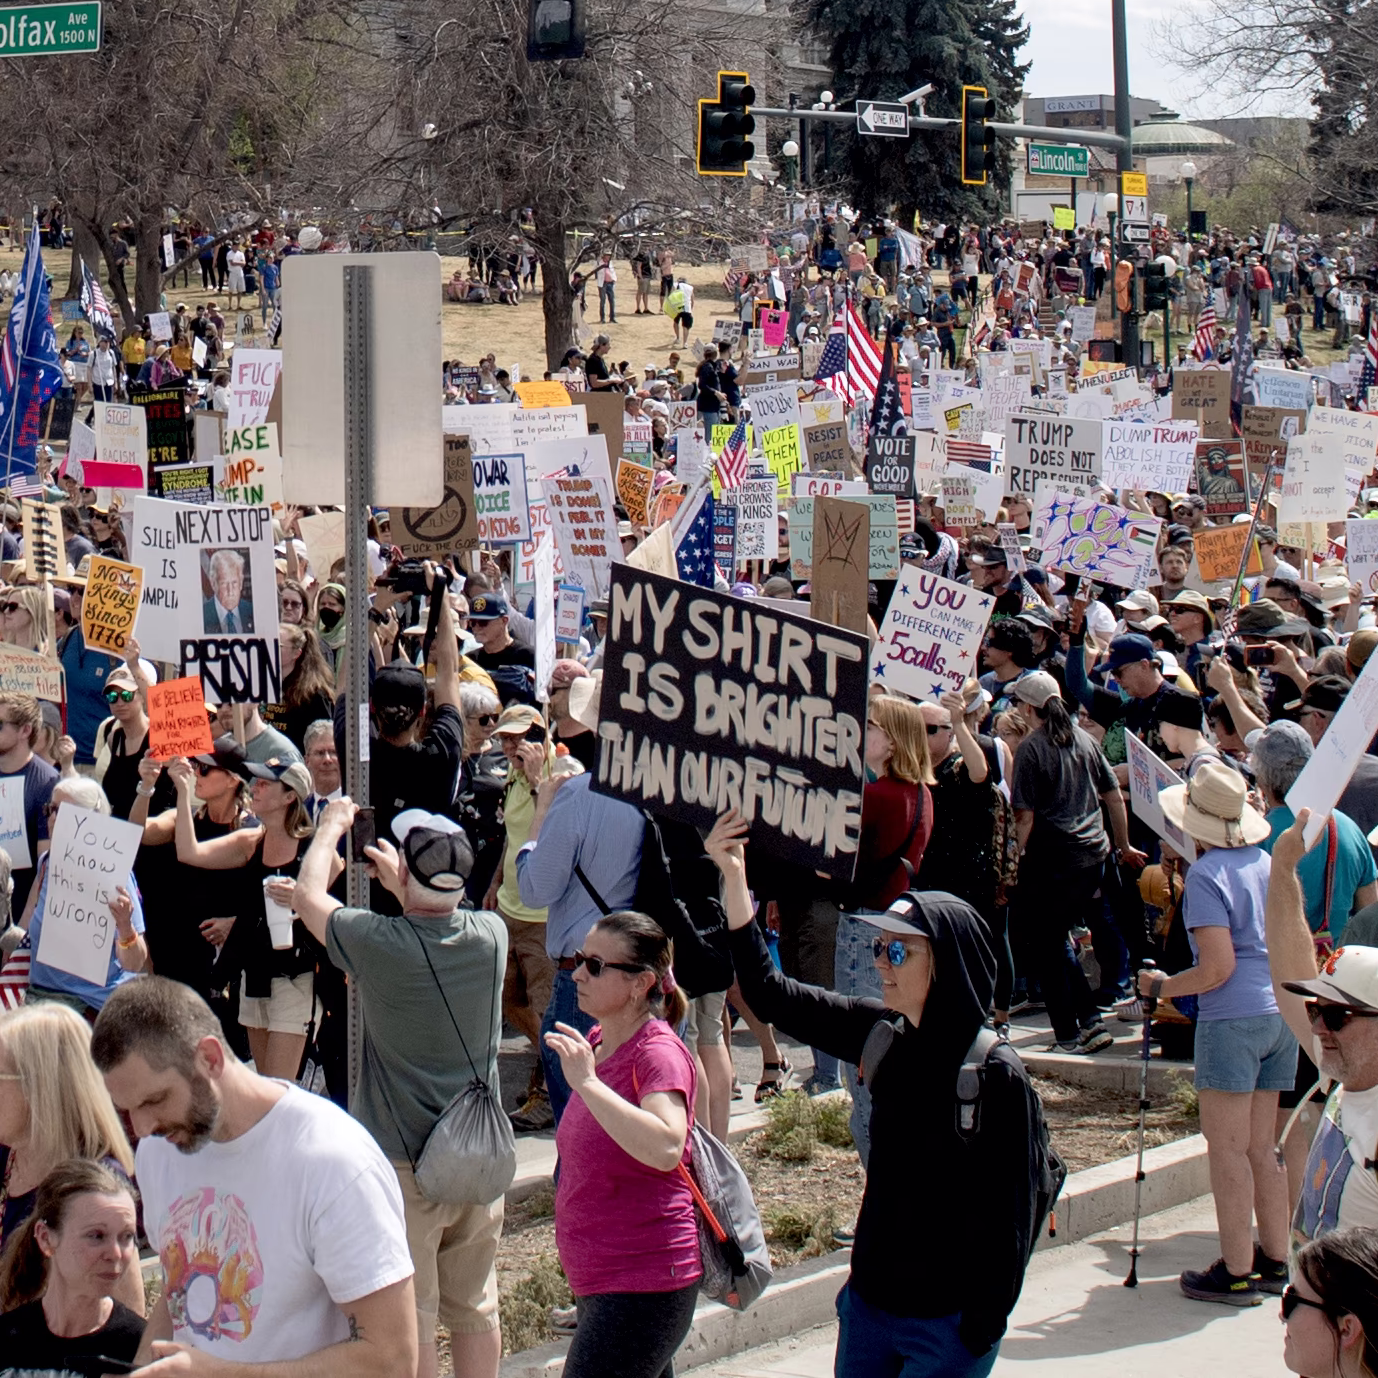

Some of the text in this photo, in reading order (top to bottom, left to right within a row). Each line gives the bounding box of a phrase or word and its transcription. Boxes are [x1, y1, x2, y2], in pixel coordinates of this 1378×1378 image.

[68, 12, 88, 26] Ave
[60, 29, 96, 43] 1500 N
[1047, 97, 1099, 111] GRANT
[873, 111, 903, 125] ONE WAY
[1039, 149, 1075, 171] Lincoln
[777, 358, 798, 367] WAR
[1182, 376, 1215, 388] HATE
[1260, 376, 1300, 389] Jefferson
[990, 391, 1027, 404] PEOPLE
[1264, 387, 1304, 400] Unitarian
[1181, 398, 1217, 407] GREAT
[1273, 397, 1303, 409] Church
[107, 409, 129, 423] STOP
[673, 406, 696, 419] NO
[1313, 411, 1371, 429] WE HAVE A
[764, 429, 794, 447] VOTE
[808, 427, 843, 443] RESIST
[1011, 418, 1074, 447] TRUMP
[1110, 426, 1197, 445] DUMP TRUMP
[765, 443, 798, 460] THEM
[813, 448, 844, 463] PEACE
[875, 438, 910, 456] VOTE
[1105, 446, 1193, 465] ABOLISH ICE
[883, 456, 898, 466] FOR
[1030, 448, 1096, 470] DOES NOT
[872, 465, 909, 484] GOOD
[557, 480, 592, 492] TRUMP
[873, 483, 906, 492] NOVEMBER
[944, 487, 969, 496] HIGH
[1152, 475, 1186, 492] SHITE
[726, 493, 773, 506] NO CROWNS
[743, 505, 773, 519] KINGS
[176, 508, 270, 544] NEXT STOP
[571, 544, 606, 557] BONES
[94, 564, 131, 584] No
[87, 583, 137, 611] Kings
[85, 602, 133, 627] Since
[930, 607, 951, 621] CAN
[89, 623, 125, 648] 1776
[892, 609, 964, 646] DIFFERENCE
[611, 582, 862, 697] MY SHIRT
[885, 631, 965, 692] 5calls.org
[180, 638, 282, 704] PRISON
[36, 677, 60, 696] files
[619, 652, 863, 779] IS BRIGHTER
[151, 737, 204, 758] EVERYONE
[597, 721, 862, 857] THAN OUR FUTURE
[74, 814, 124, 855] You
[52, 865, 109, 904] this is
